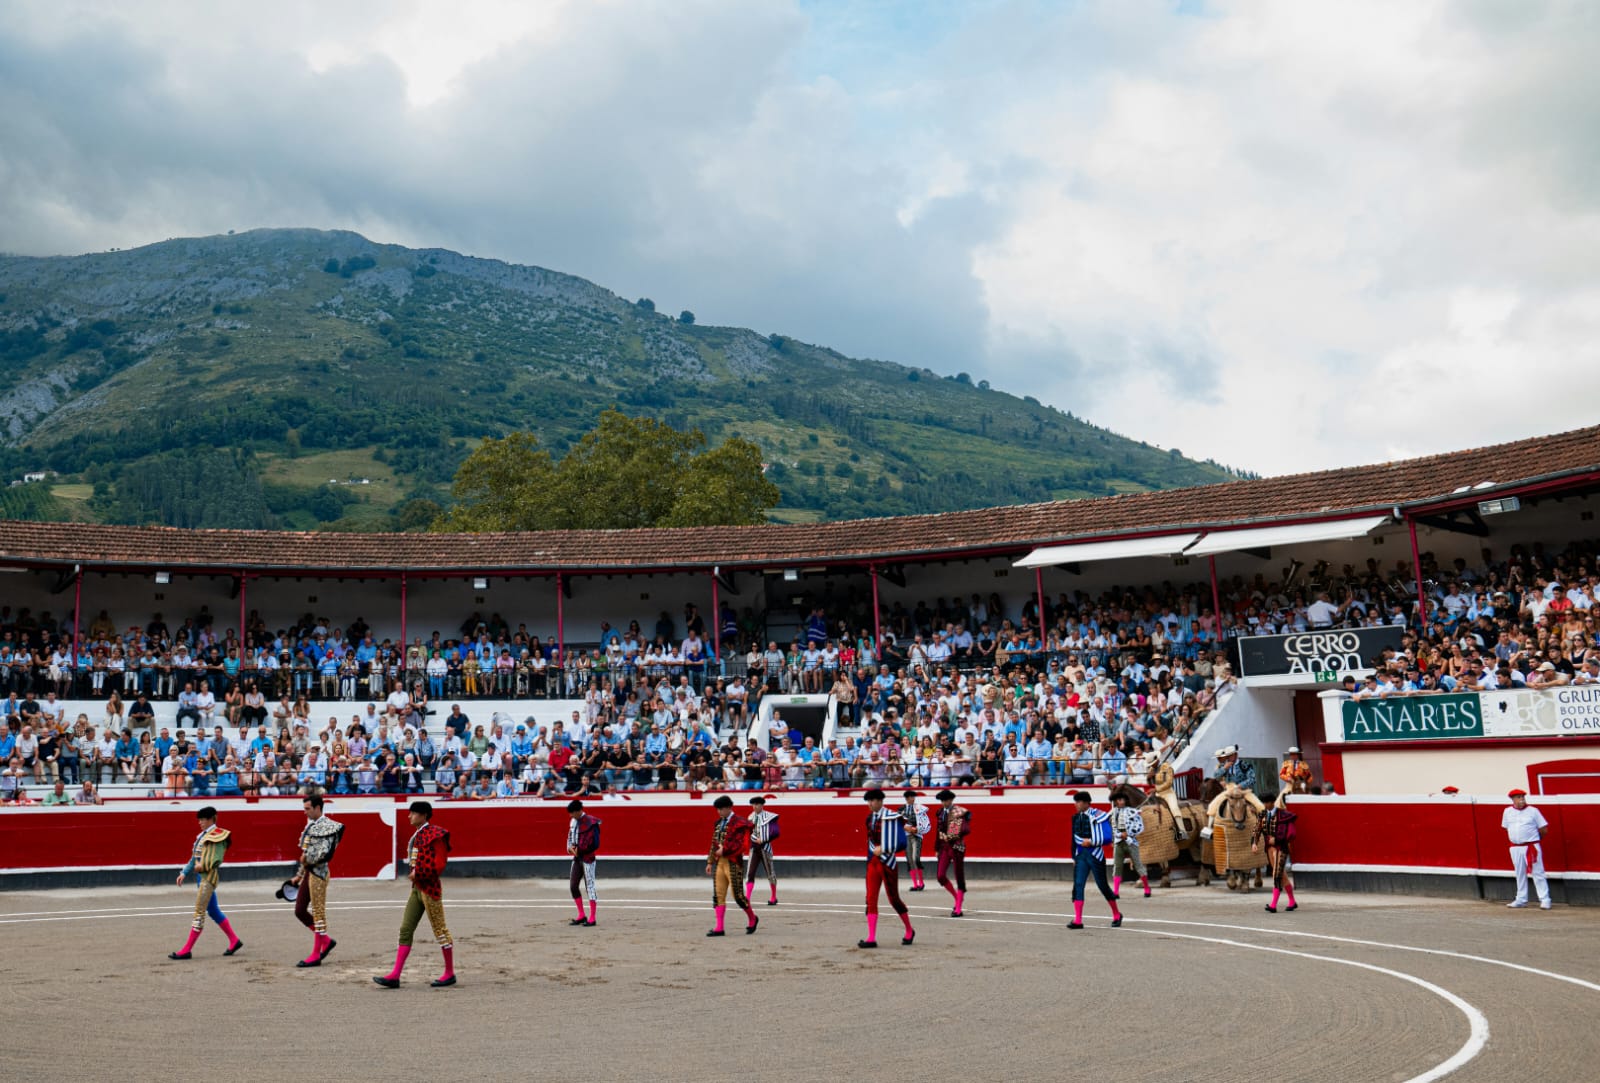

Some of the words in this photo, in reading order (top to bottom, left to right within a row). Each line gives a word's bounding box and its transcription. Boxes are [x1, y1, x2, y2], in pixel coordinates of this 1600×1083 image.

[1284, 632, 1360, 655] CERRO
[1350, 701, 1477, 734] AÑARES
[1562, 717, 1600, 729] OLAR
